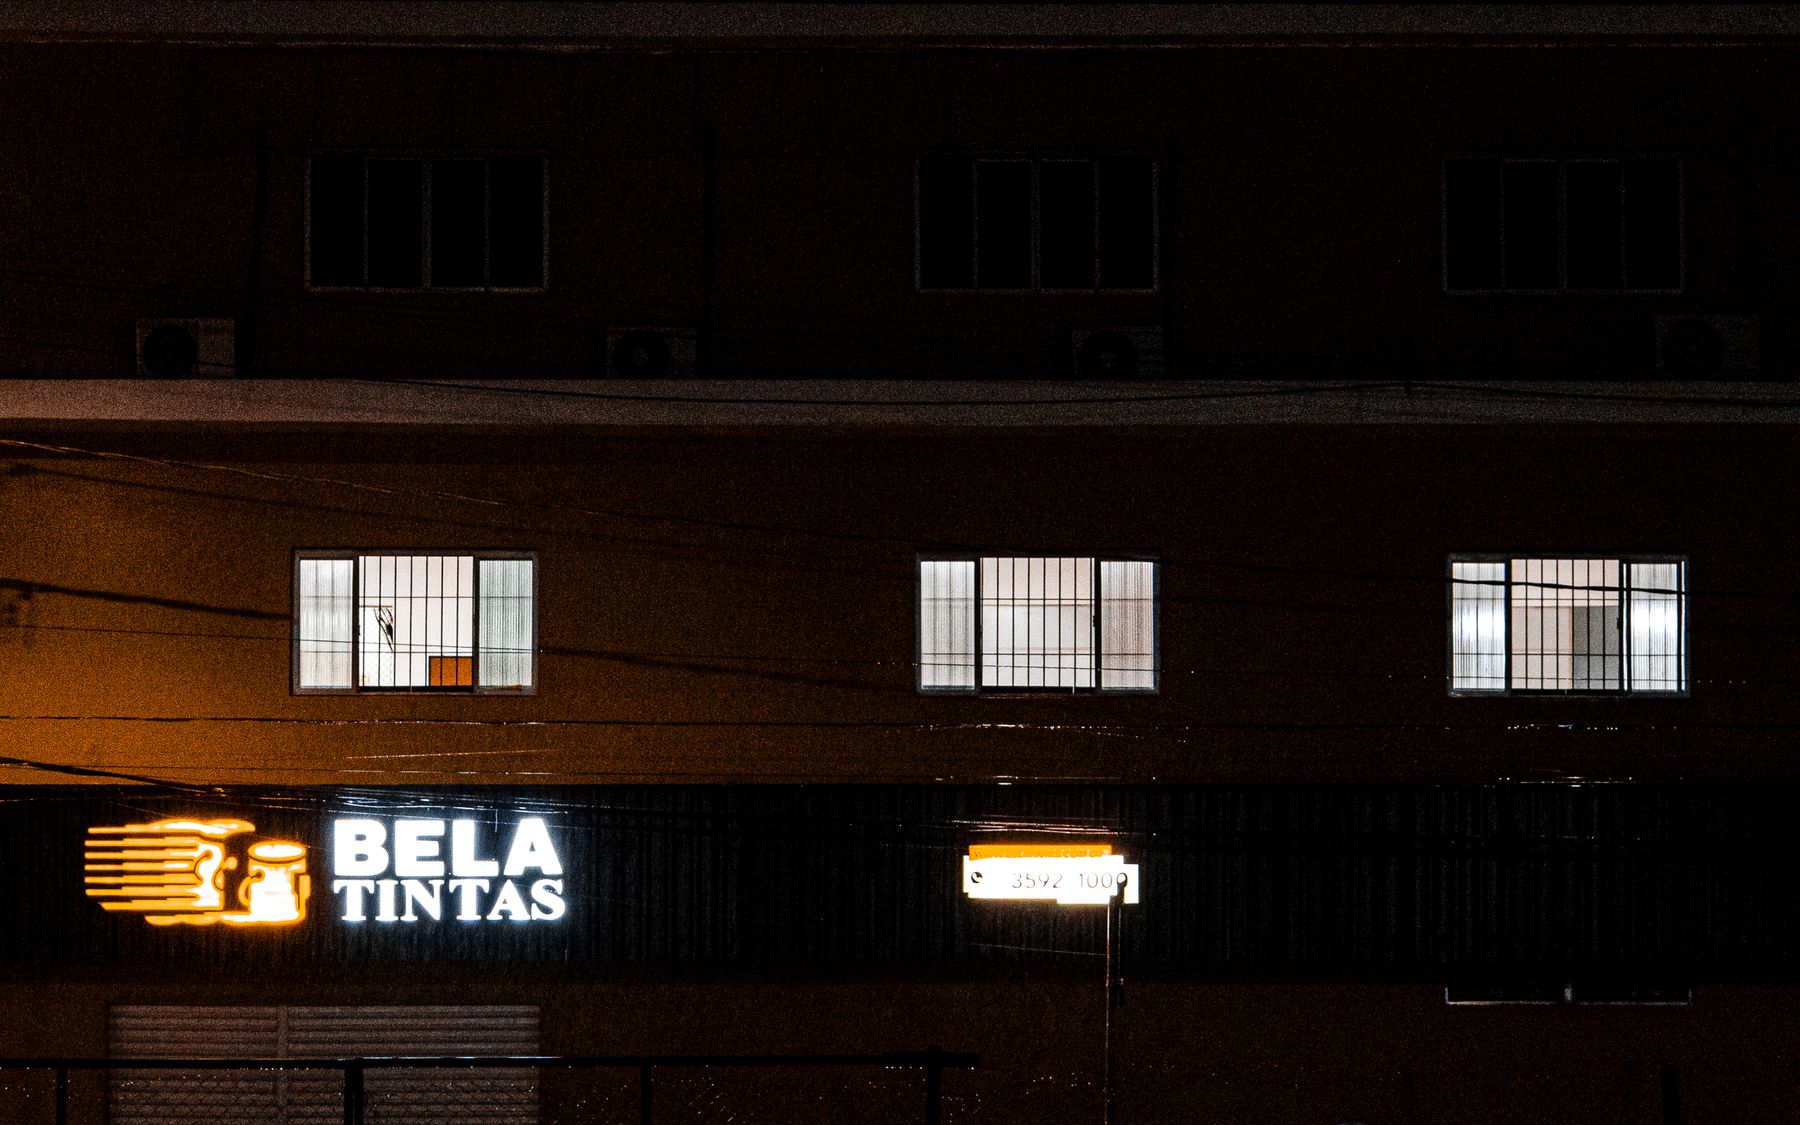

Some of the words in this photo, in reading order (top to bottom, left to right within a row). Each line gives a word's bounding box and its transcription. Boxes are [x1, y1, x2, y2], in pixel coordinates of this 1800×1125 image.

[333, 819, 563, 876] BELA
[333, 879, 566, 921] TINTAS
[1011, 872, 1063, 889] 3592
